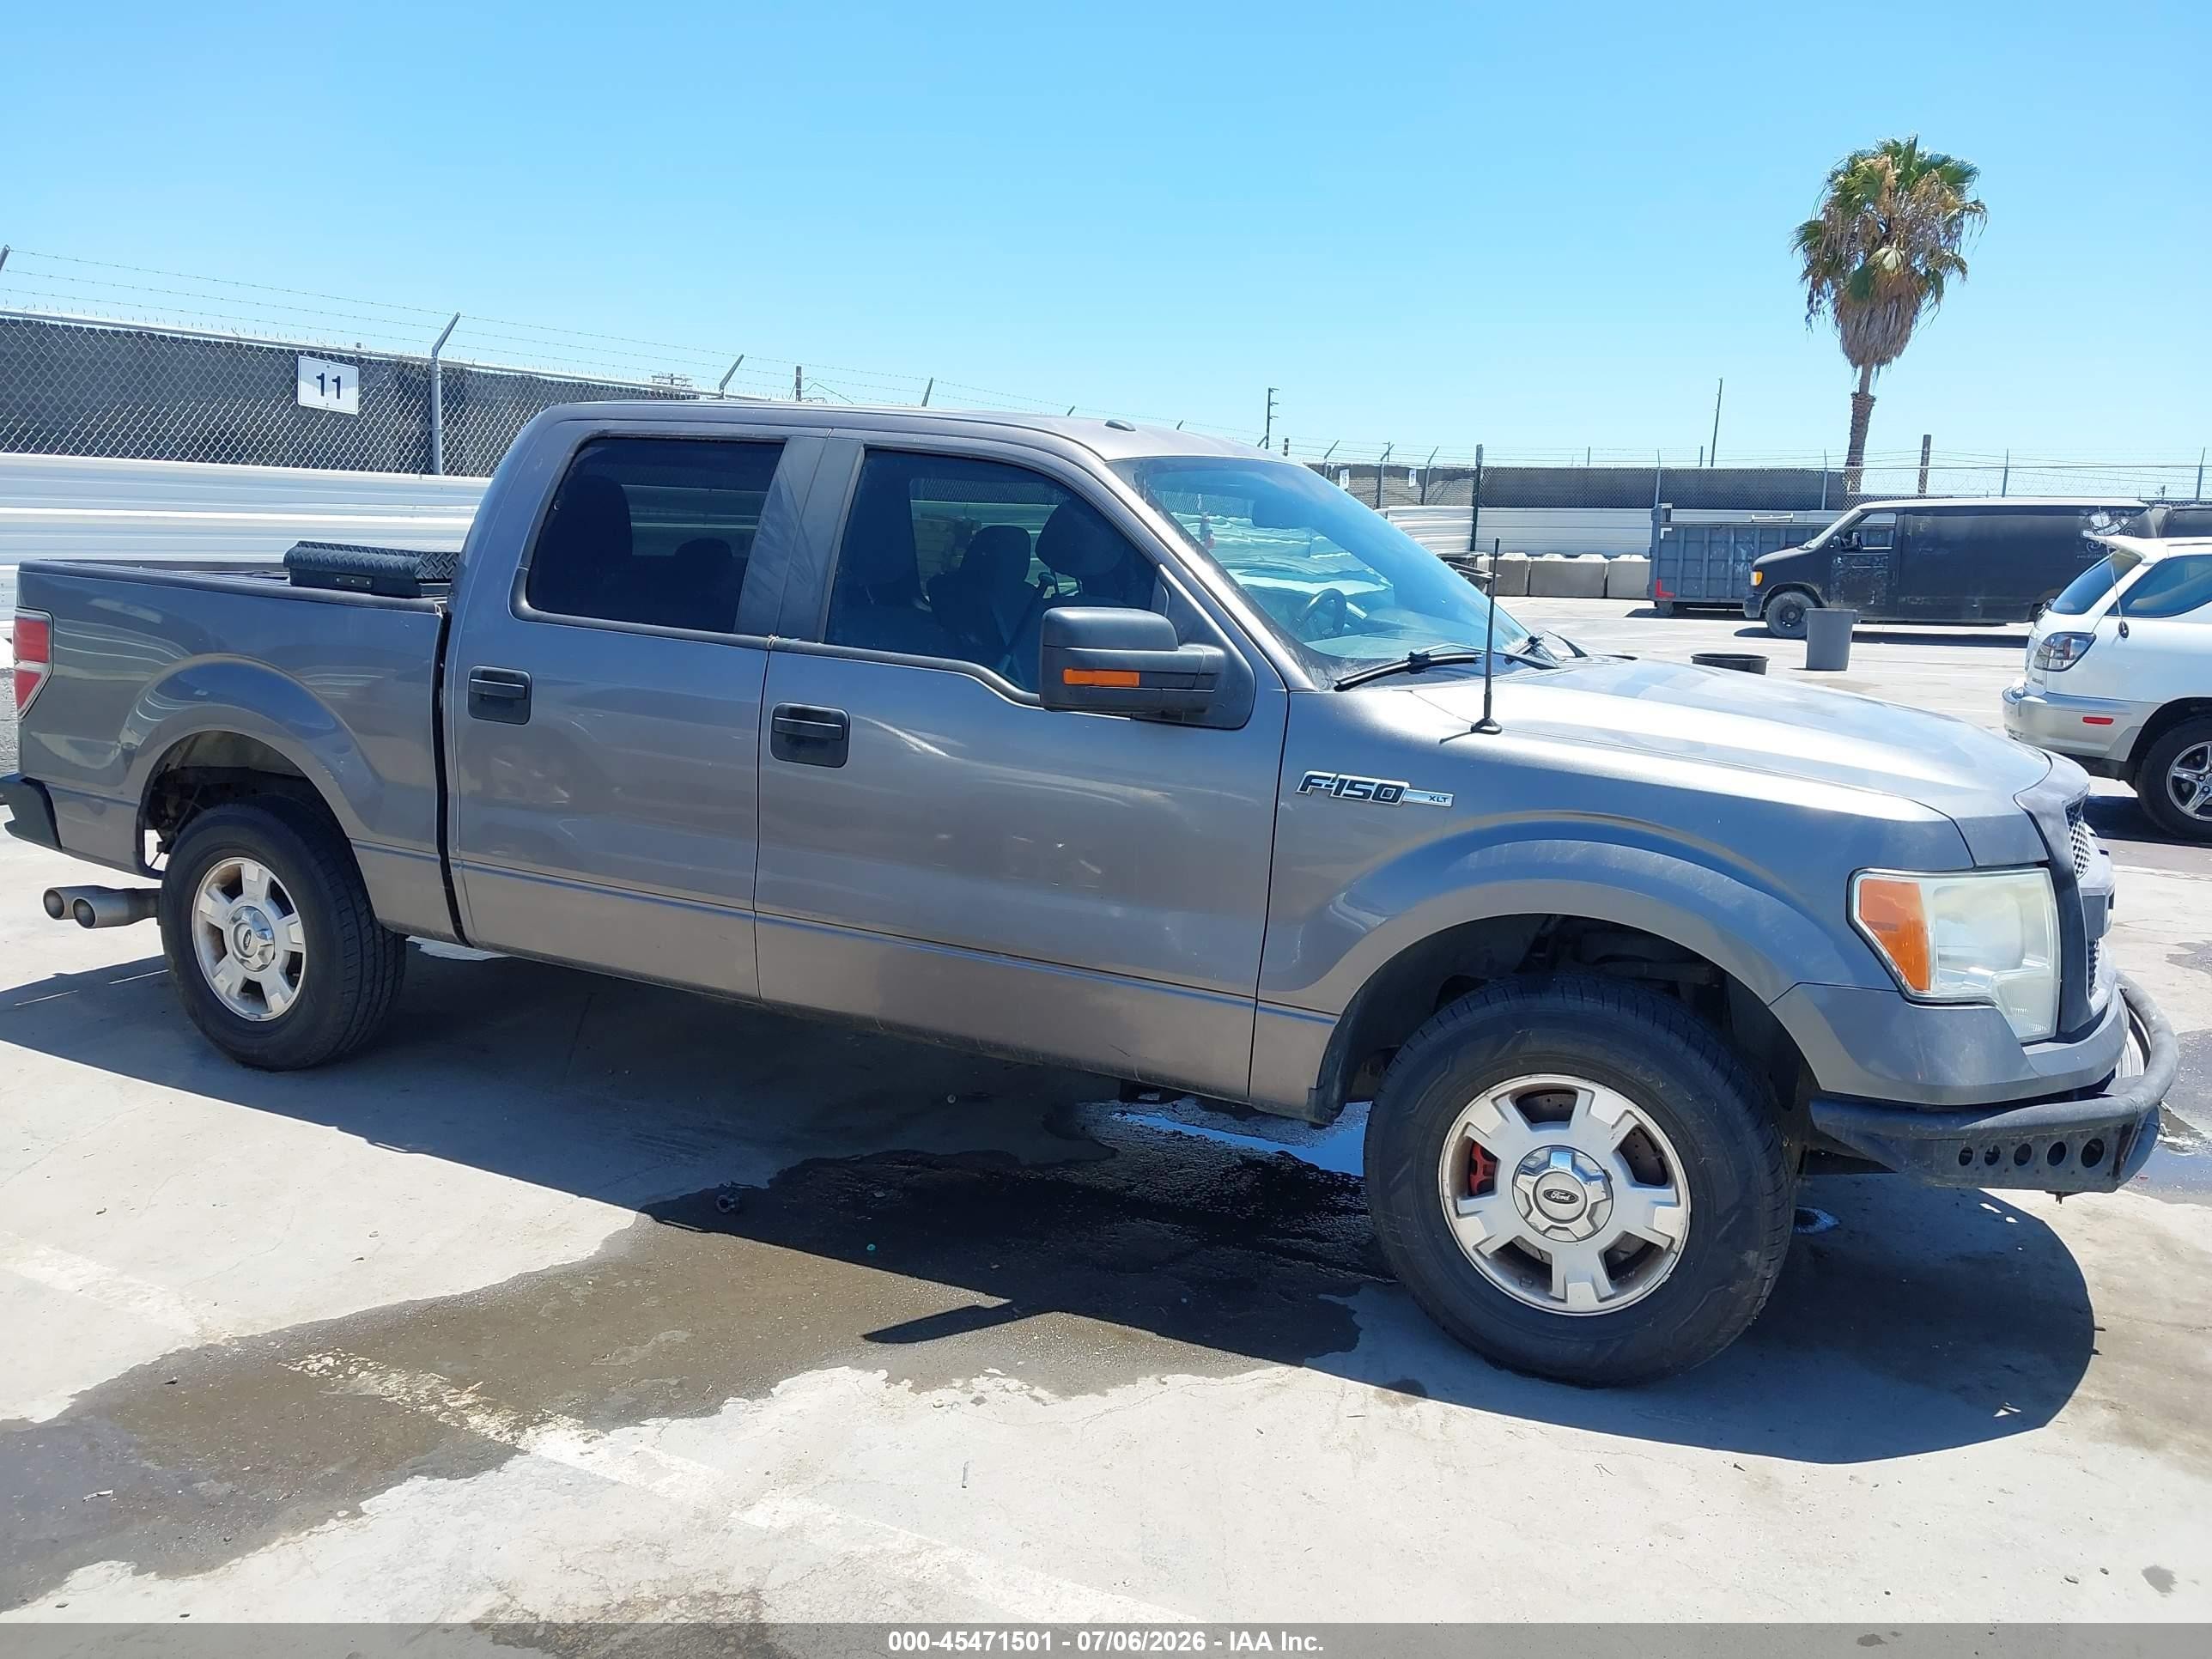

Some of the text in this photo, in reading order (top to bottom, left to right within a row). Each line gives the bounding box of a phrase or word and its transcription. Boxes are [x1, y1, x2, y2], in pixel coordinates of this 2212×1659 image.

[316, 373, 341, 399] 11
[1297, 772, 1409, 806] F-150
[1551, 1191, 1571, 1200] Ford
